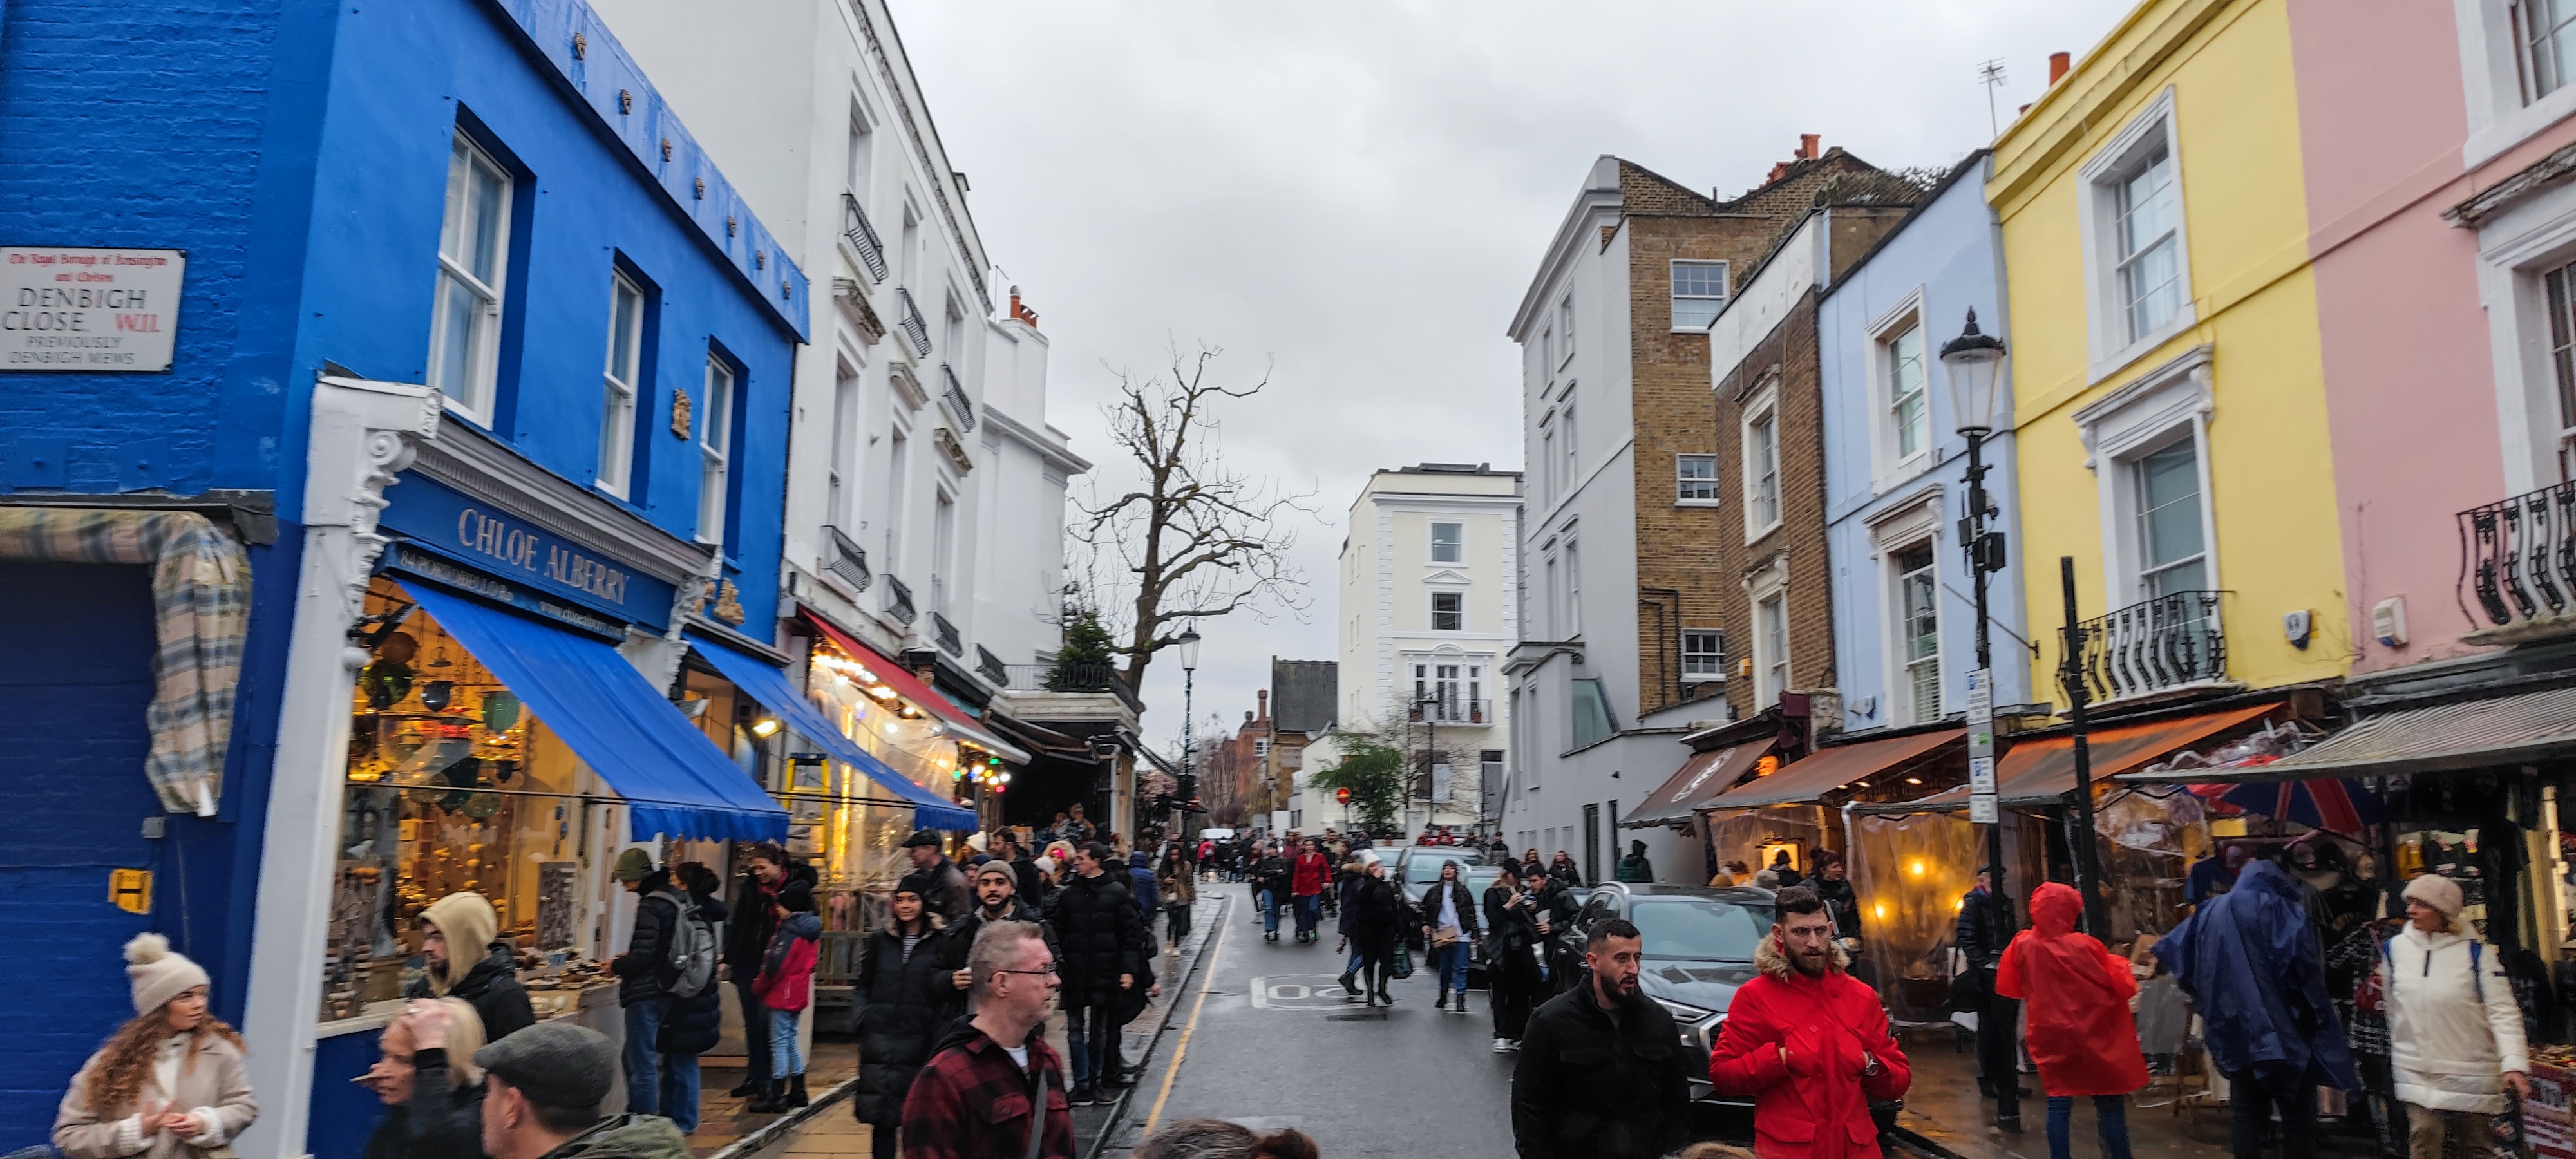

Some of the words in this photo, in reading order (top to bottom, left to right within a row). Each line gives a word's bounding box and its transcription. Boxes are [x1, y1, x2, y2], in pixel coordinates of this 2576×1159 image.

[17, 288, 147, 309] DENBIGH
[25, 336, 123, 348] PREVIOUSLY
[9, 352, 83, 363] DENBIGH
[86, 352, 135, 364] MEWS
[458, 508, 539, 572] CHLOE
[544, 545, 630, 605] ALBERRY
